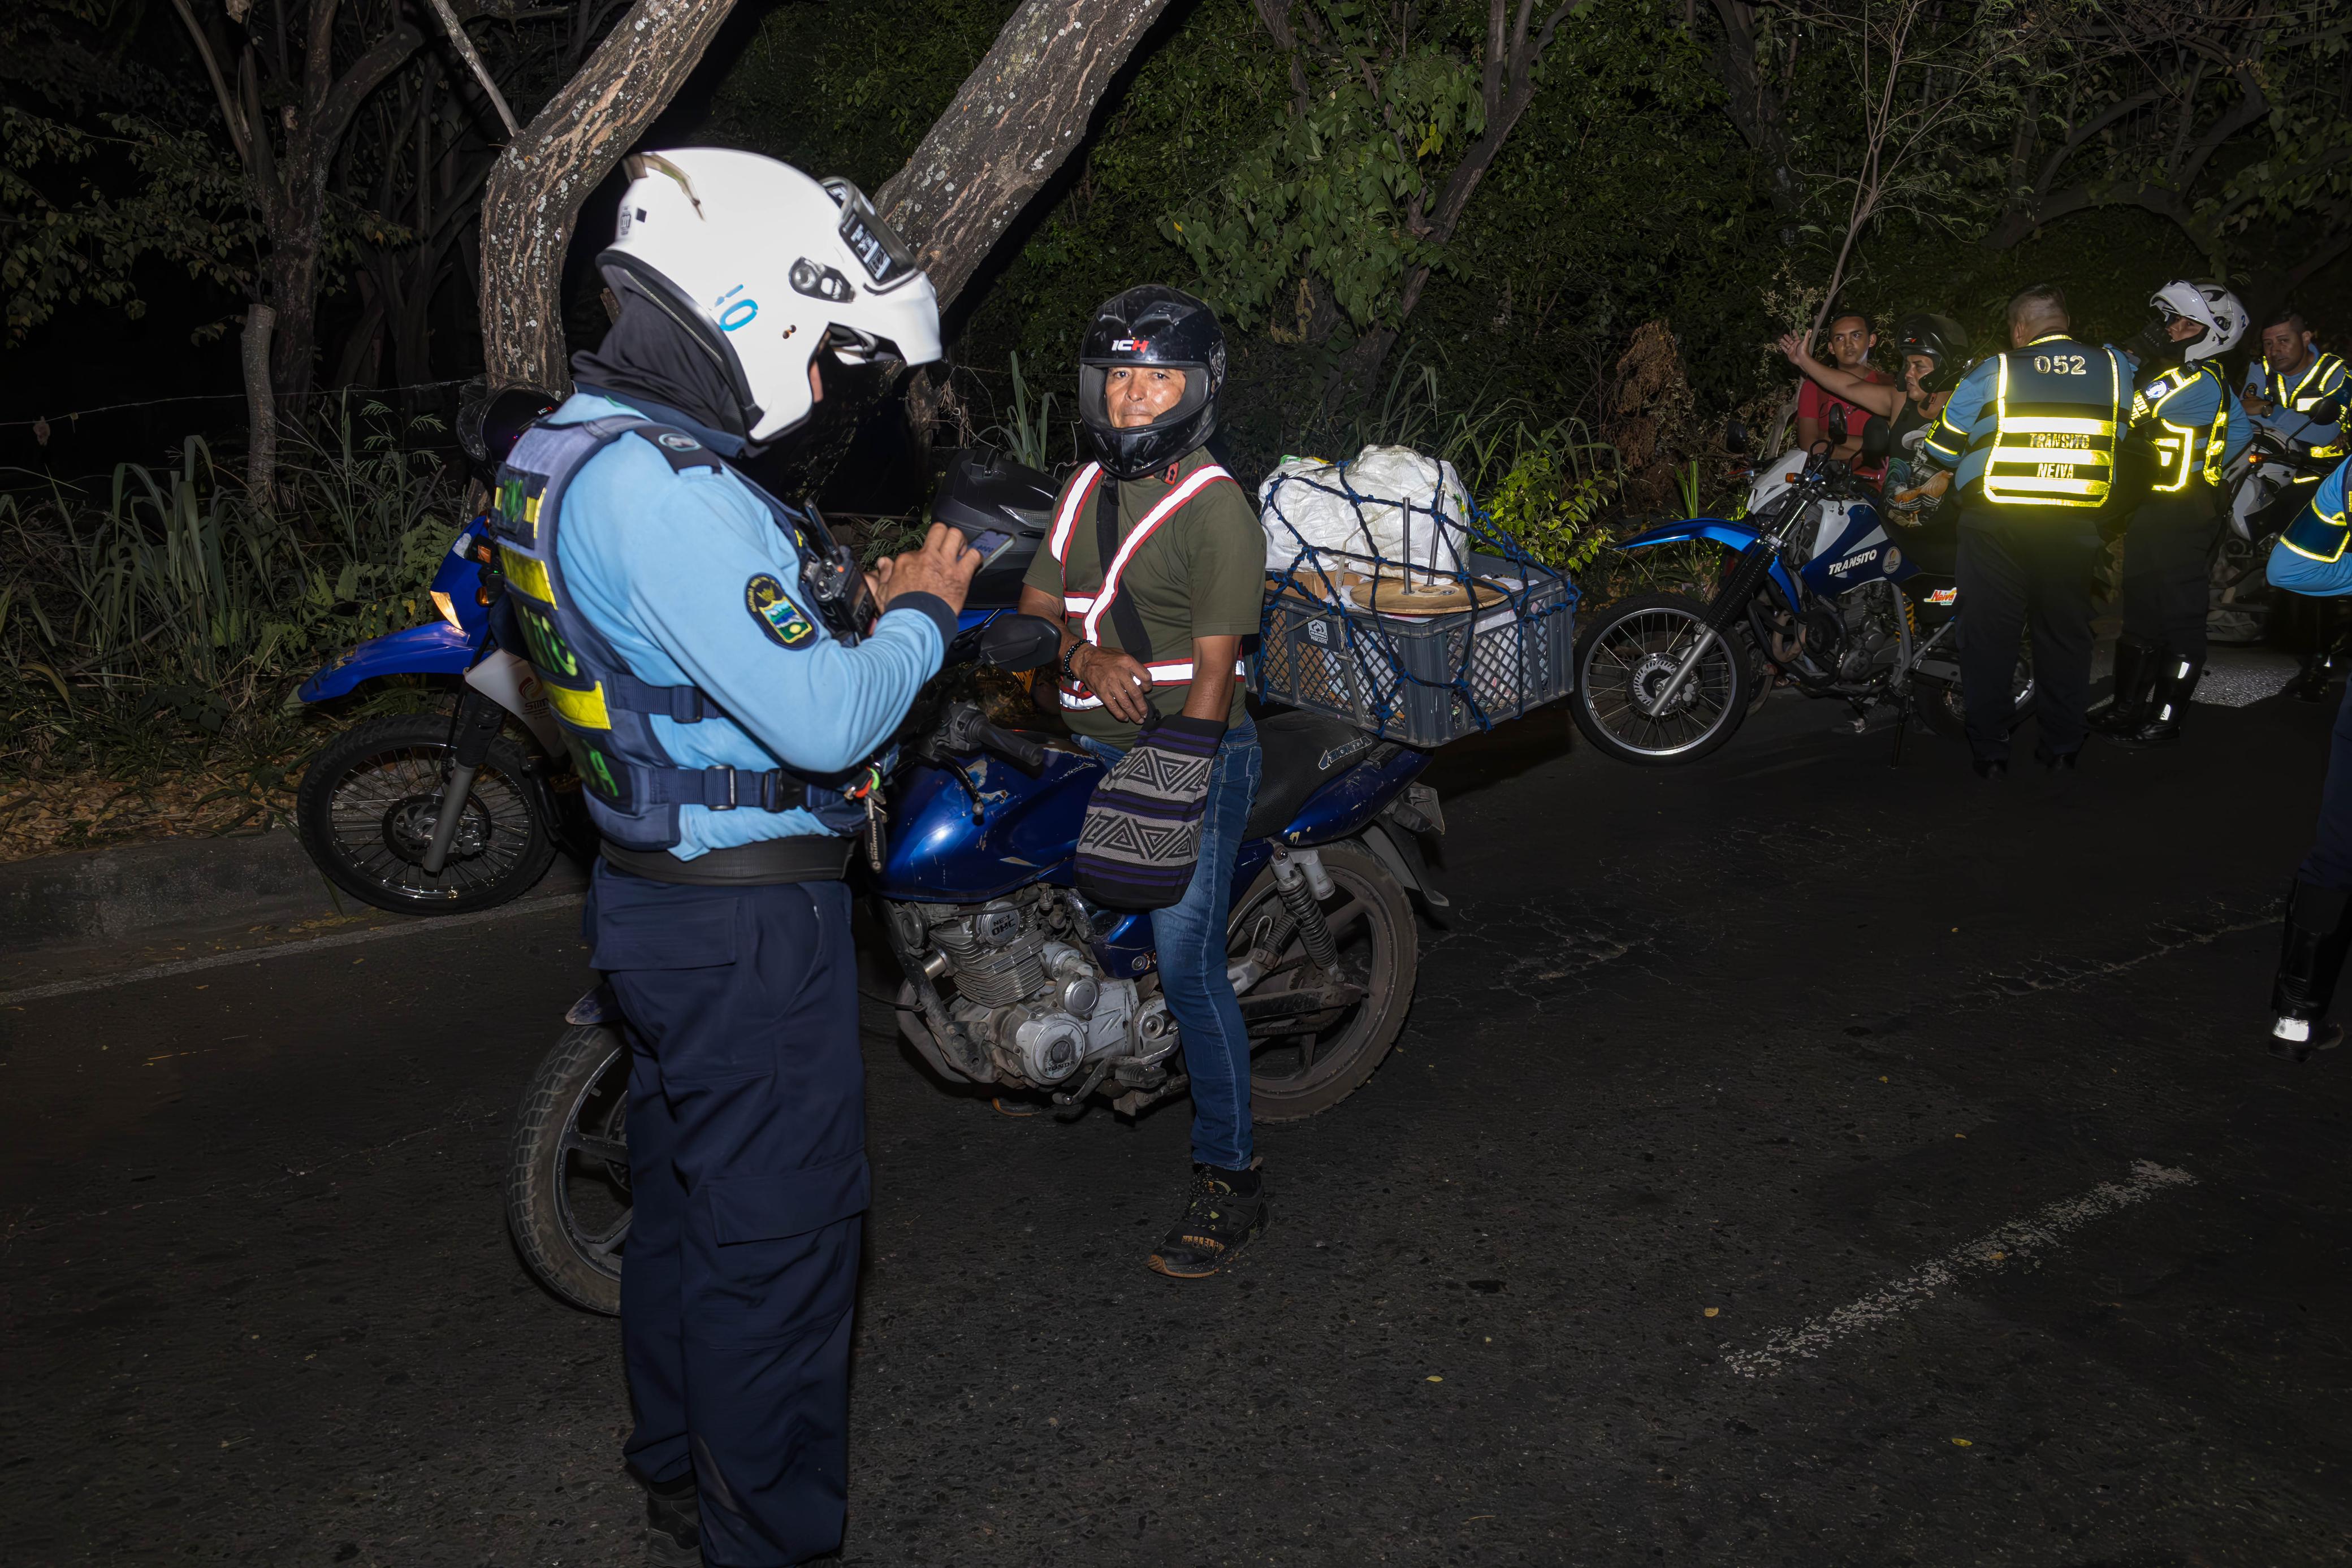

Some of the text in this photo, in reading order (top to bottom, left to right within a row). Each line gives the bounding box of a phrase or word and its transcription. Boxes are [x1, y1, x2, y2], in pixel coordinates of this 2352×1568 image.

[2034, 355, 2086, 375] 052
[2029, 433, 2090, 449] TRANSITO
[2037, 464, 2074, 479] NEIVA
[1828, 549, 1877, 575] TRANSITO
